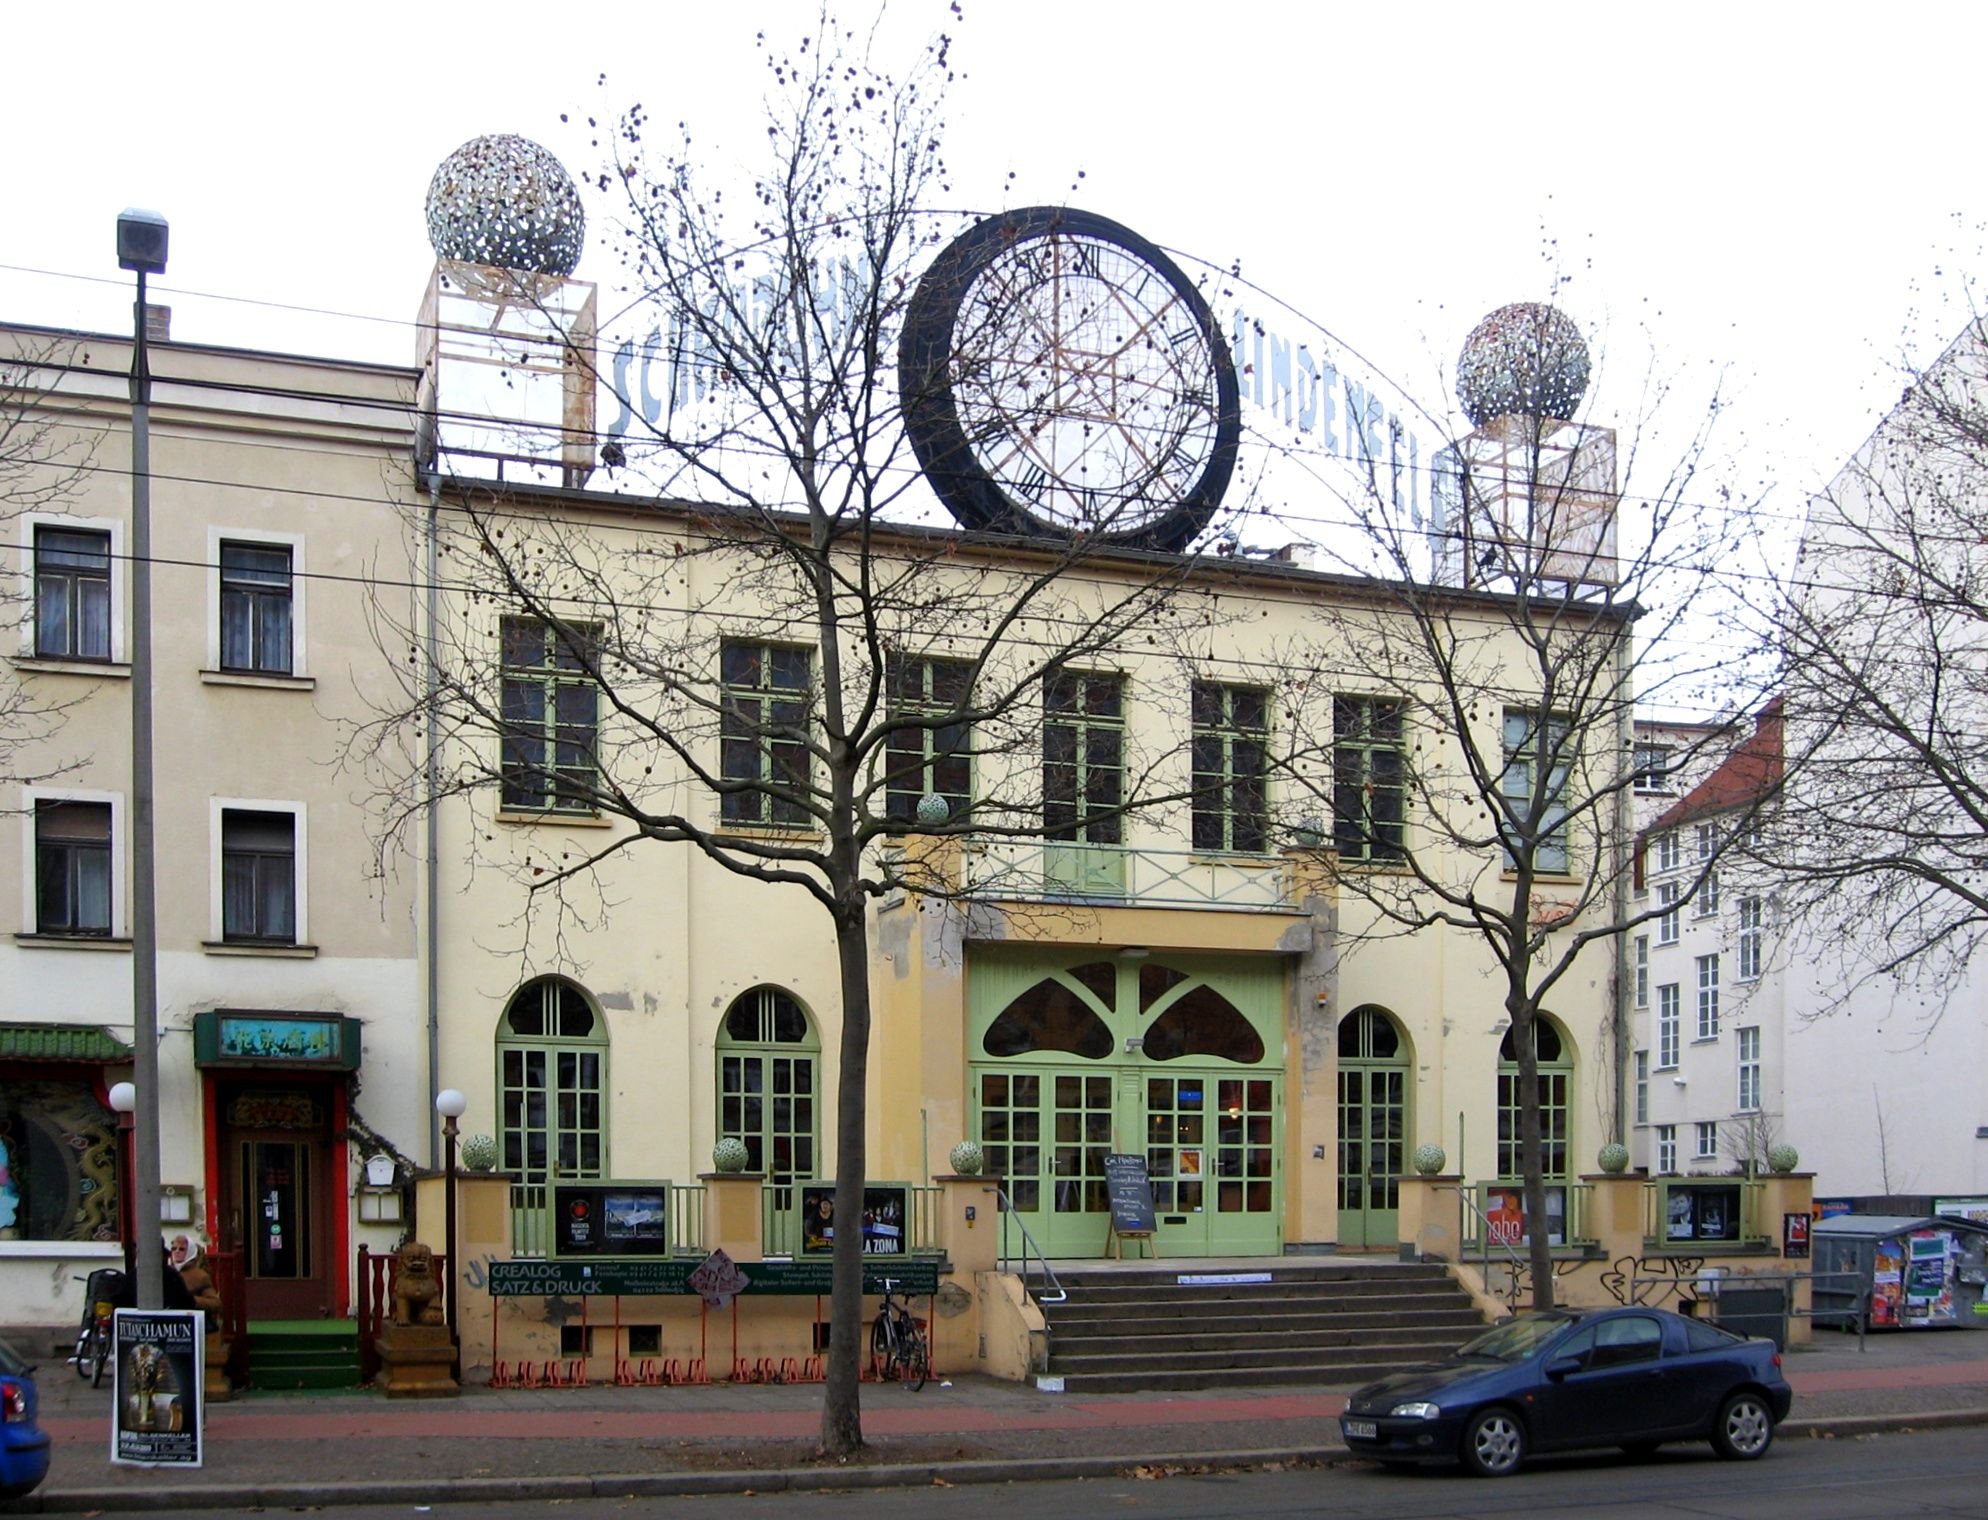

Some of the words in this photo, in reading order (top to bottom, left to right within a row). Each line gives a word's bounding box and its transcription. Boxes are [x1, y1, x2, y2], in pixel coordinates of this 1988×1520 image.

[1234, 308, 1451, 556] LINDENFELS
[873, 1238, 899, 1254] ZONA
[491, 1265, 561, 1278] CREALOG
[119, 1321, 191, 1338] TUTANCHAMUN
